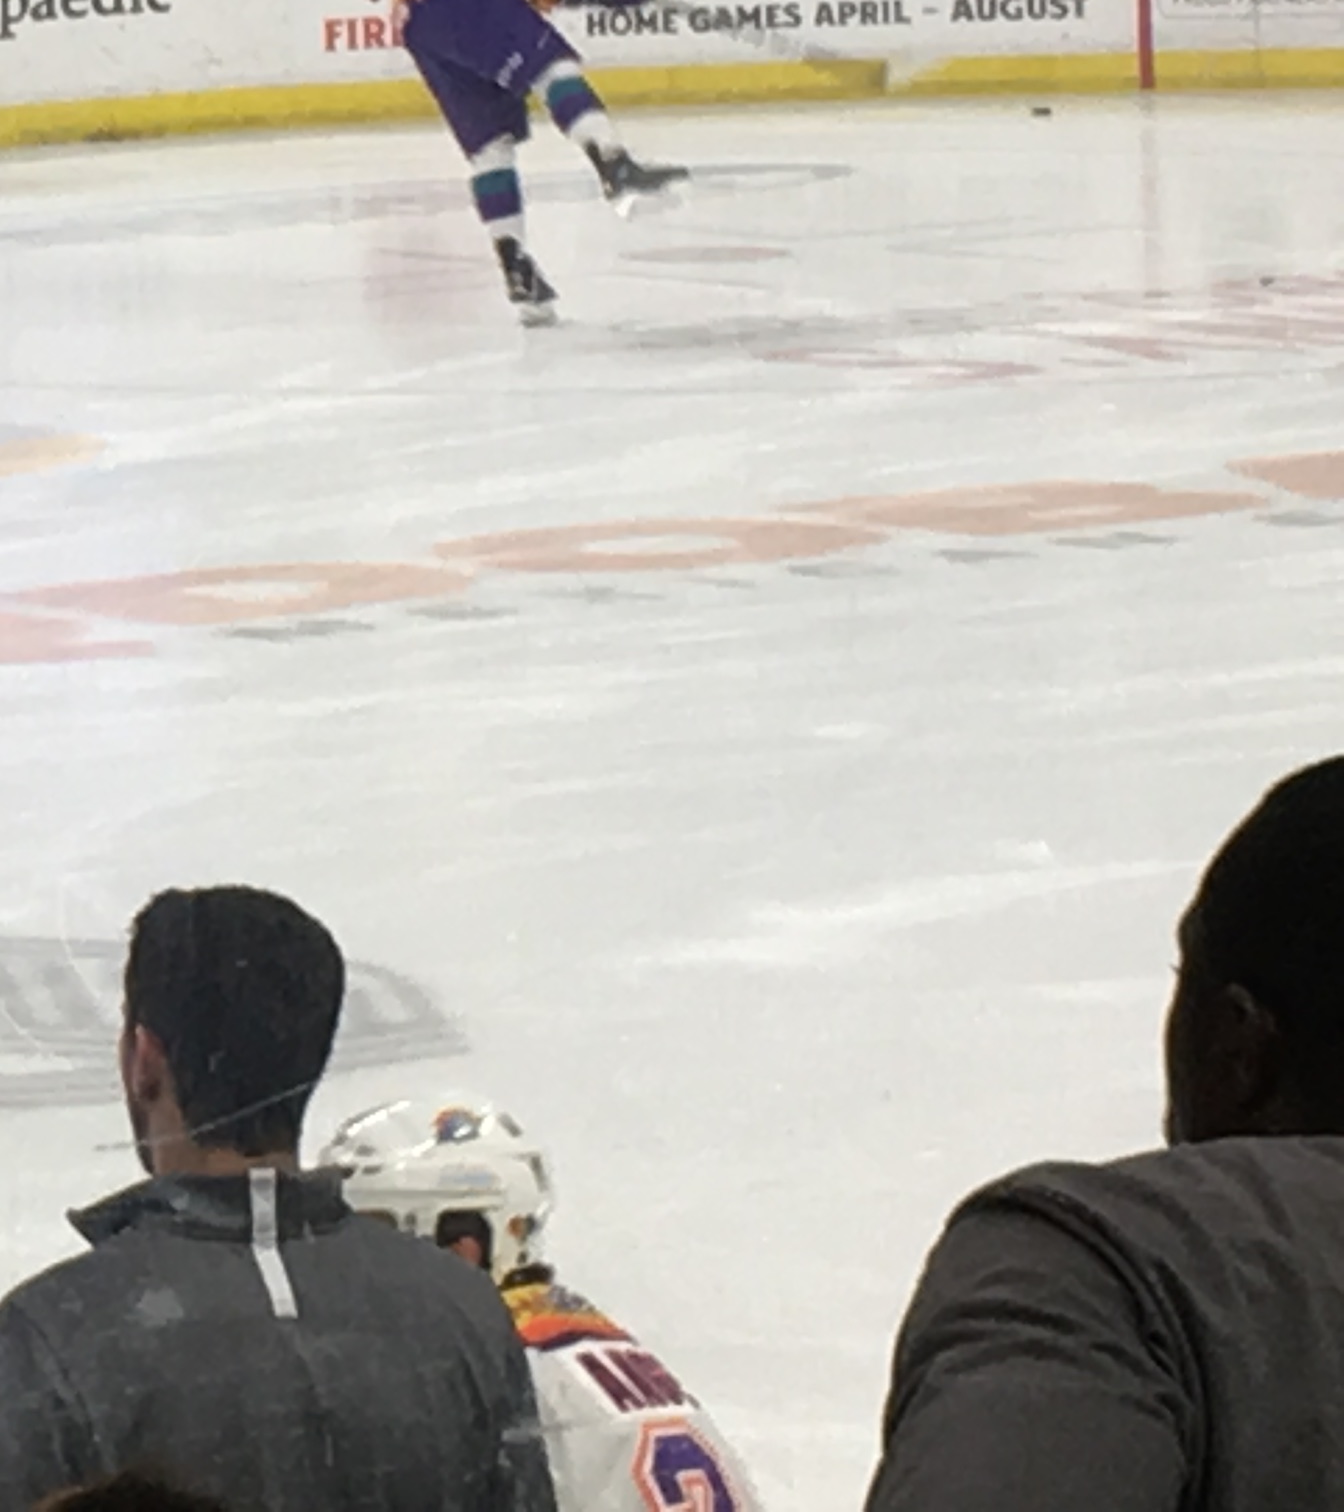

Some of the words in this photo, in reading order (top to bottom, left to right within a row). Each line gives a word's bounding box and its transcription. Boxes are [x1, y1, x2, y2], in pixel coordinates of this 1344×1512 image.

[586, 5, 679, 36] HOME
[688, 2, 801, 32] GAMES
[814, 0, 911, 26] APRIL
